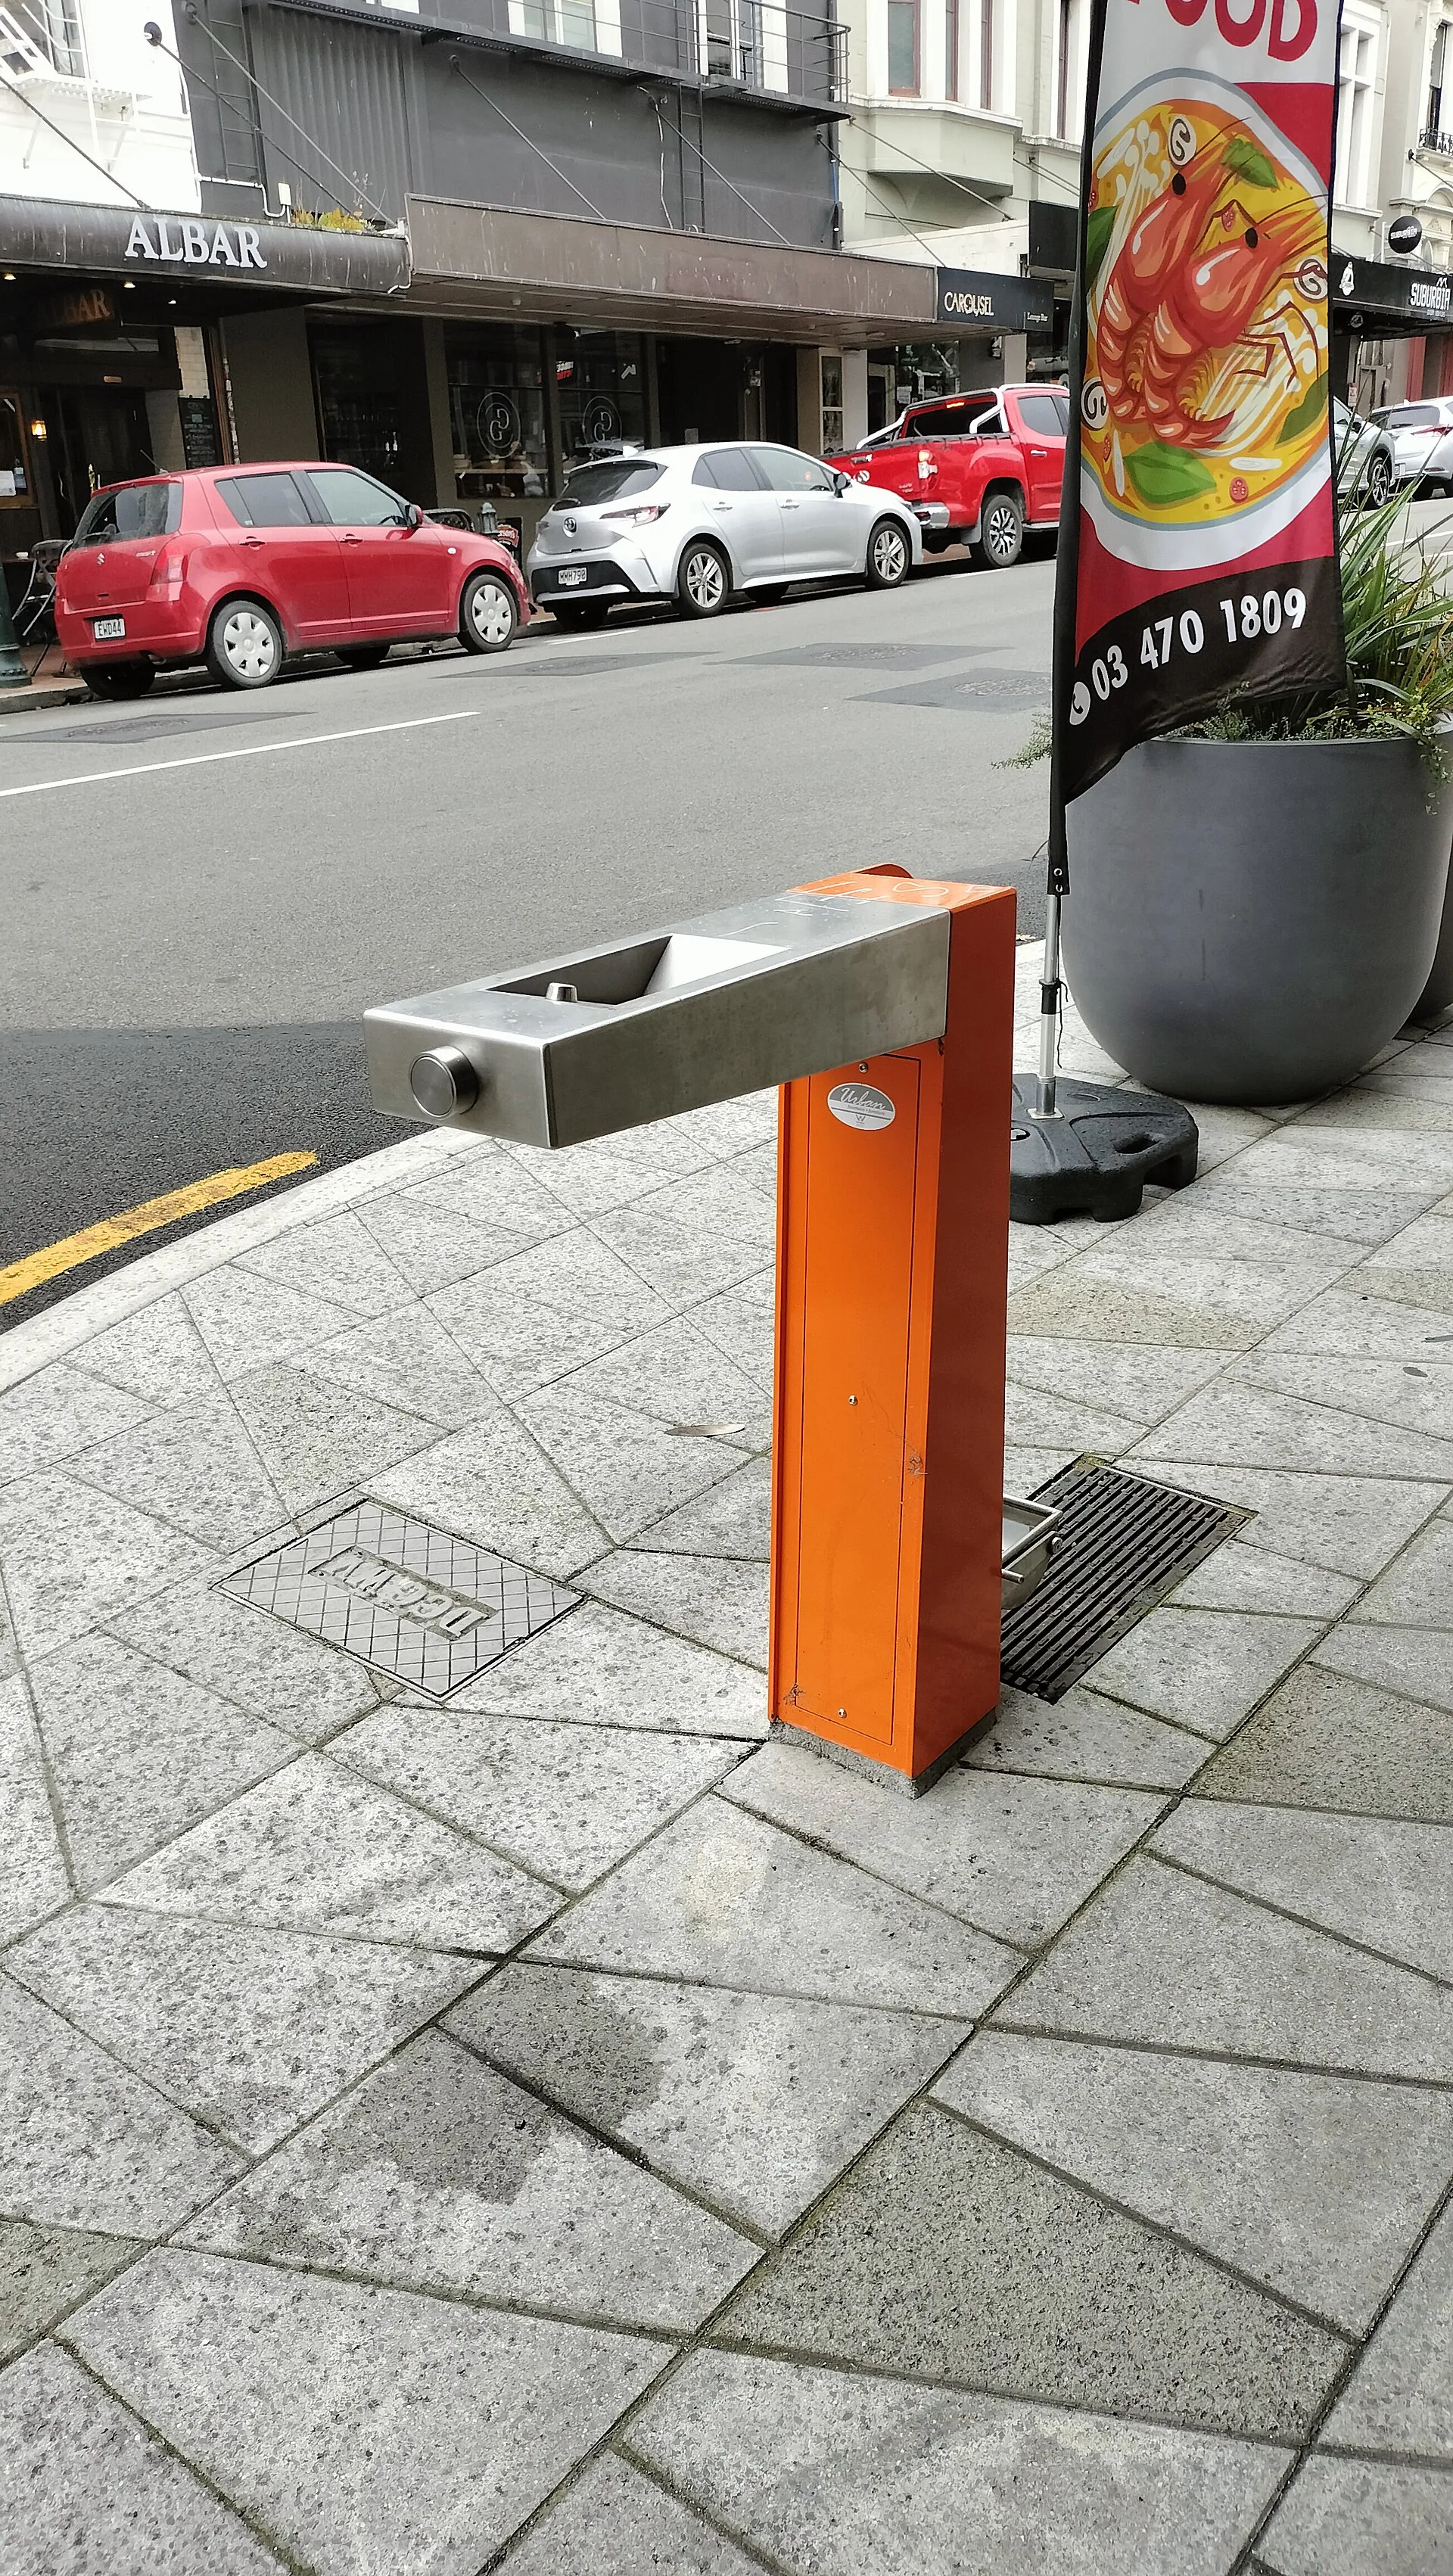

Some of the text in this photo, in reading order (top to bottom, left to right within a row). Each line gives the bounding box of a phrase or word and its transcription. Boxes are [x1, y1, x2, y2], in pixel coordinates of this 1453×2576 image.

[125, 215, 268, 268] ALBAR
[944, 291, 994, 317] CAROUSEL
[1410, 282, 1451, 311] SUBURBIA
[1092, 588, 1306, 700] 03 470 1809
[841, 1087, 885, 1109] Urban
